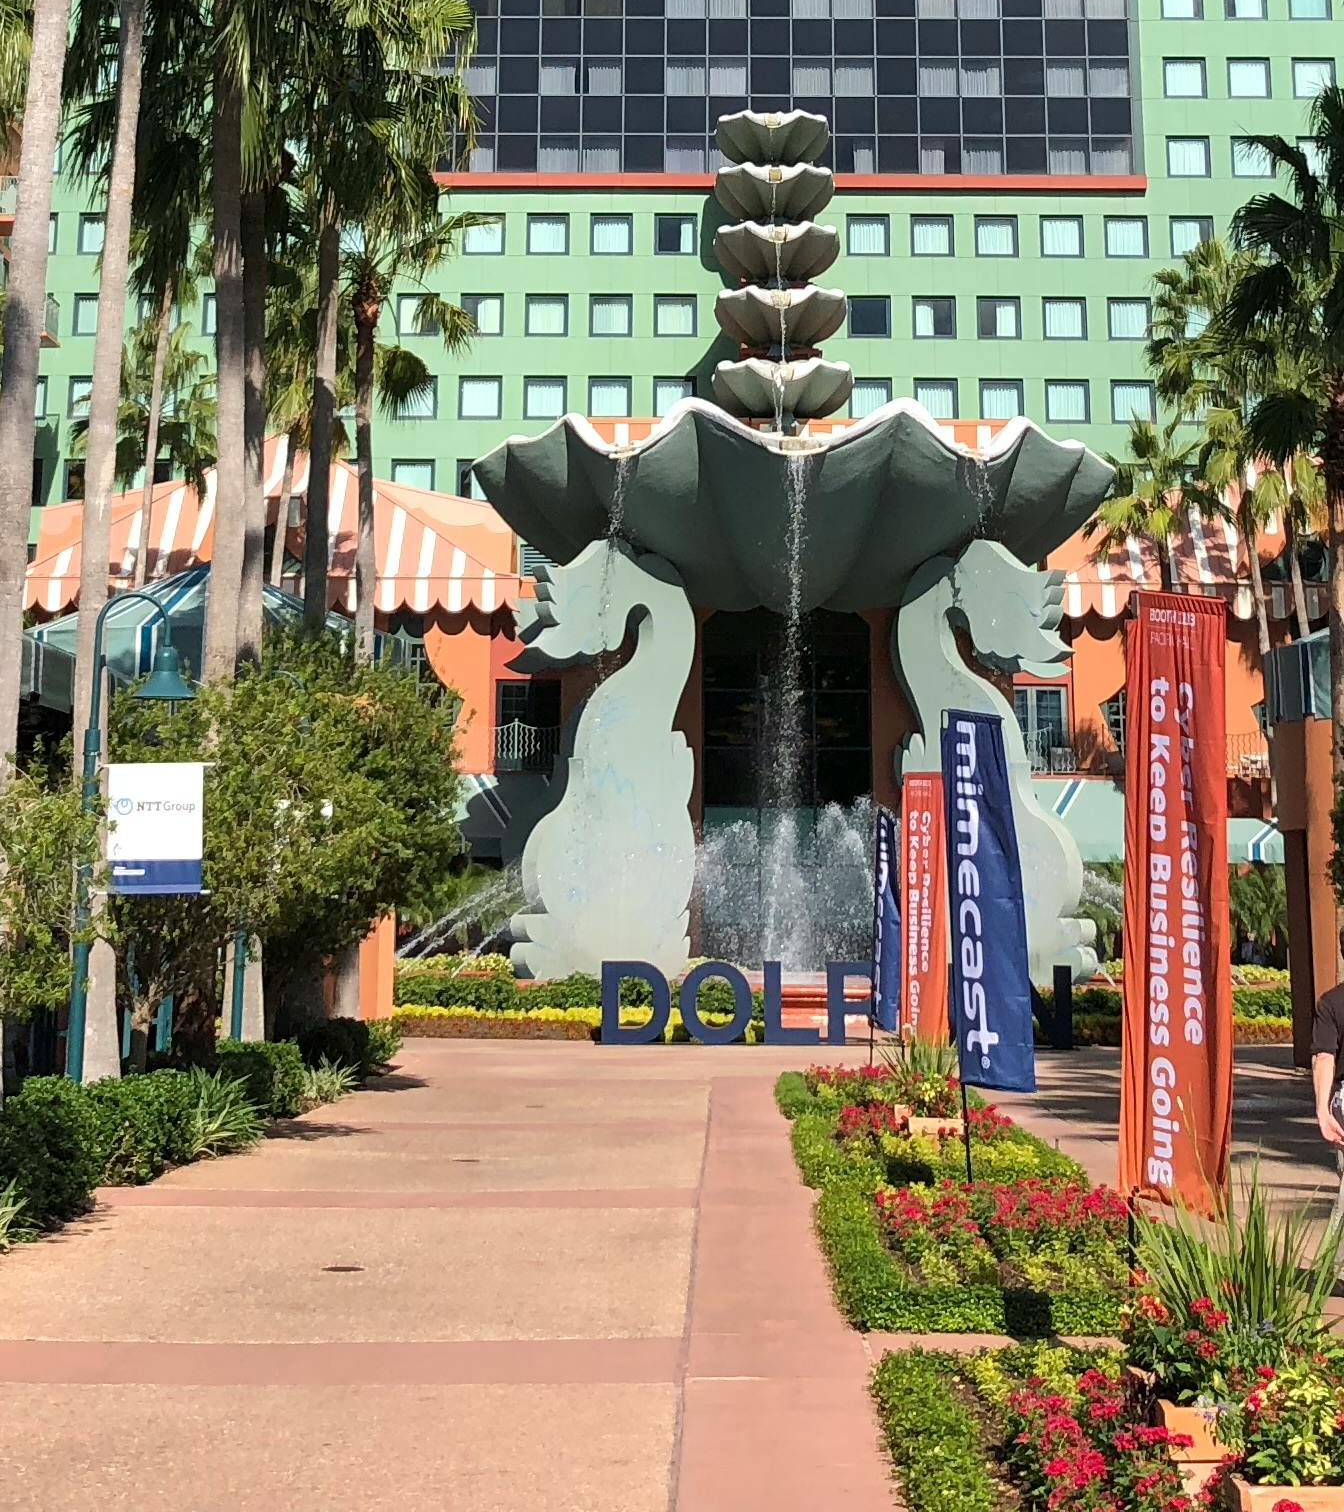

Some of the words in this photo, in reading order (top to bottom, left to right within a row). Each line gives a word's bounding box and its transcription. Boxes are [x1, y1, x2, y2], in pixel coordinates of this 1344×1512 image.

[1149, 607, 1177, 624] BOOTH
[1150, 676, 1170, 723] to
[1173, 681, 1195, 812] Cyber
[136, 800, 162, 812] NTT
[163, 800, 196, 814] Group
[1149, 733, 1170, 842] Keep
[907, 888, 920, 977] Business
[1149, 853, 1176, 1047] Business
[1180, 820, 1206, 1045] Resilience
[1147, 1056, 1180, 1187] Going
